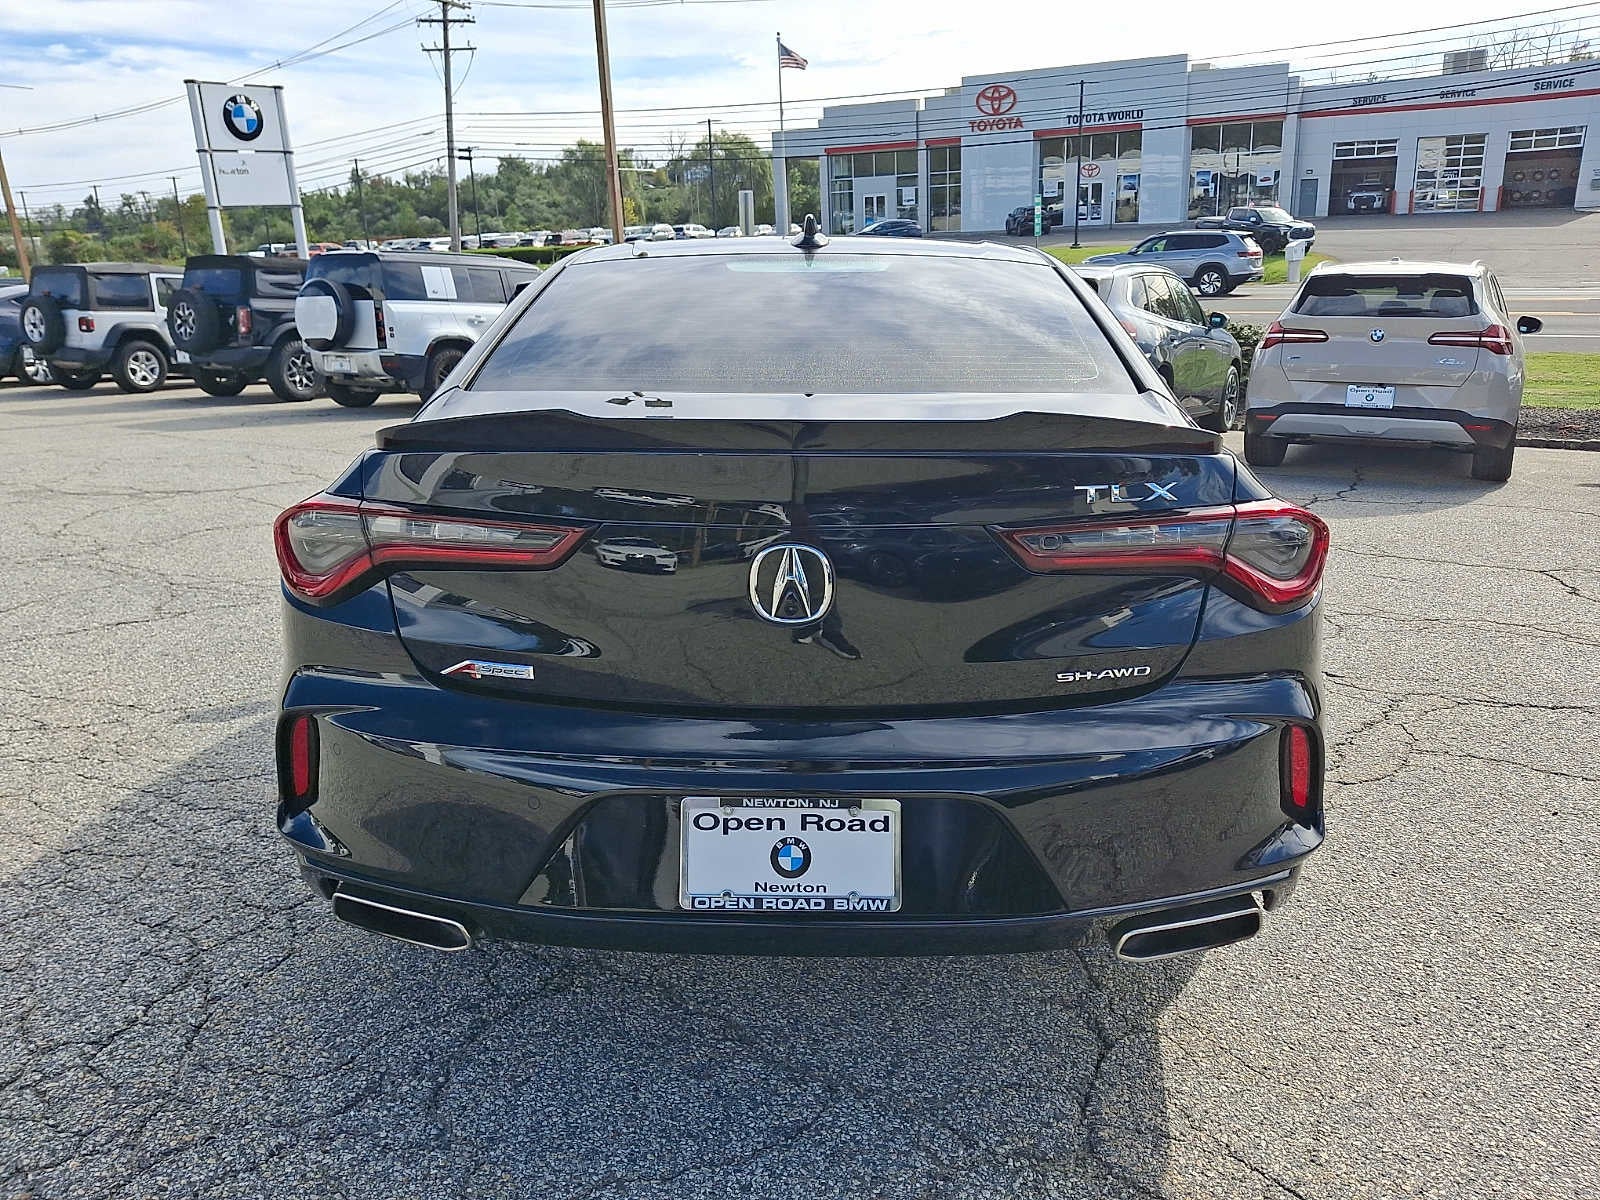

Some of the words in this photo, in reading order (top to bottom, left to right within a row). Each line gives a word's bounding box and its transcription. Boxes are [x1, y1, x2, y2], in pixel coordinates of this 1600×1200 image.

[1534, 78, 1575, 91] SERVICE
[1440, 88, 1477, 99] SERVICE
[225, 95, 260, 111] BMW
[1352, 95, 1388, 106] SERVICE
[1066, 112, 1105, 126] TOYOTA
[1107, 109, 1144, 122] WORLD
[968, 117, 1024, 132] TOYOTA
[219, 168, 249, 176] ton
[1074, 481, 1178, 504] TLX
[1056, 666, 1151, 683] SH-AWD
[742, 798, 814, 808] NEWTON,
[818, 798, 840, 808] NJ
[692, 812, 786, 836] Open
[800, 813, 890, 832] Road
[775, 837, 808, 850] BMW
[754, 881, 827, 893] Newton
[694, 897, 760, 911] OPEN
[762, 898, 826, 911] ROAD
[833, 898, 889, 911] BMW
